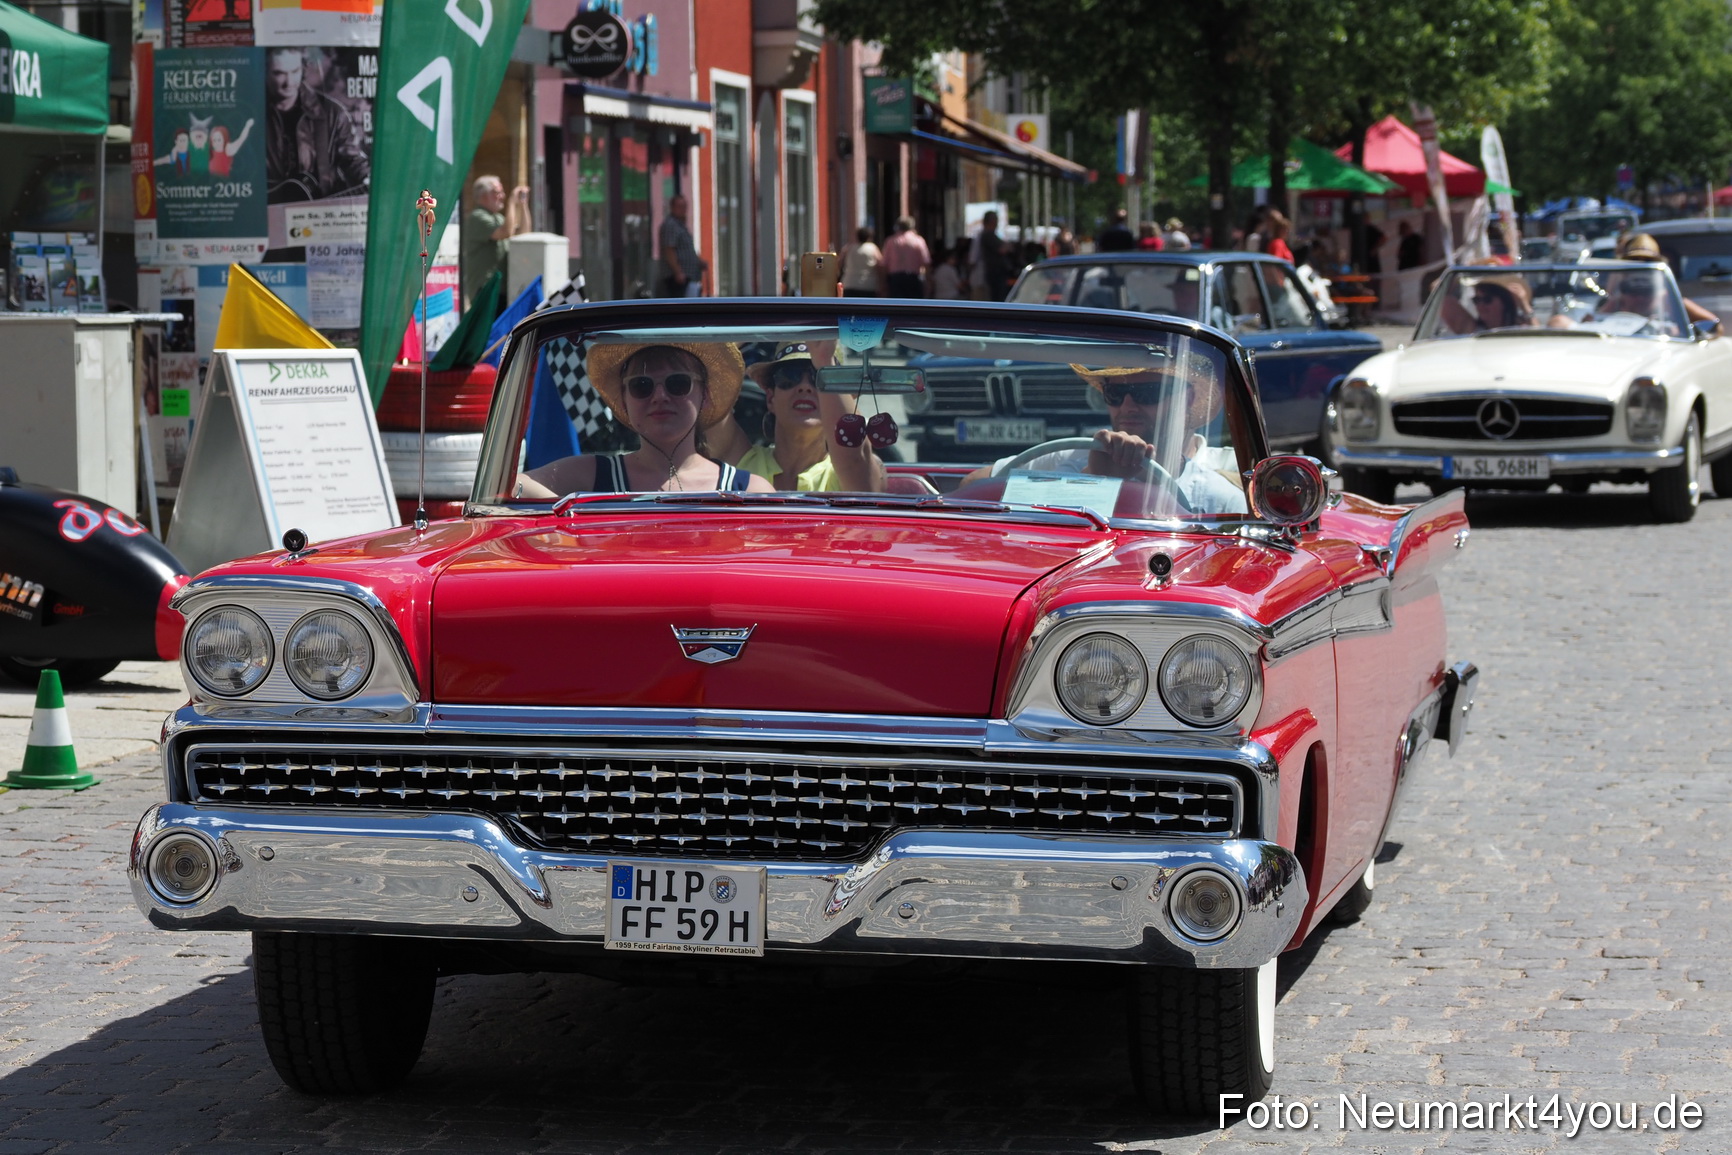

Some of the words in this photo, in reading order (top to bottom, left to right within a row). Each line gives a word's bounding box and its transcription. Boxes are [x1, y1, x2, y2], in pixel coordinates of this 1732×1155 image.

[163, 69, 237, 91] KELTEN
[156, 182, 211, 199] Sommer
[215, 182, 252, 198] 2018
[204, 244, 255, 254] NEUMARKT
[309, 246, 331, 257] 950
[285, 363, 329, 379] DEKRA
[248, 384, 356, 398] RENNFAHRZEUGSCHAU
[1453, 460, 1464, 474] N
[1474, 459, 1494, 476] SL
[1498, 460, 1538, 475] 968H
[635, 869, 704, 903] HIP
[621, 905, 666, 938] FF
[615, 941, 632, 949] 1959
[633, 942, 651, 950] Ford
[652, 943, 681, 951] Fairlane
[683, 944, 713, 954] Skyliner
[714, 946, 756, 955] Retractable
